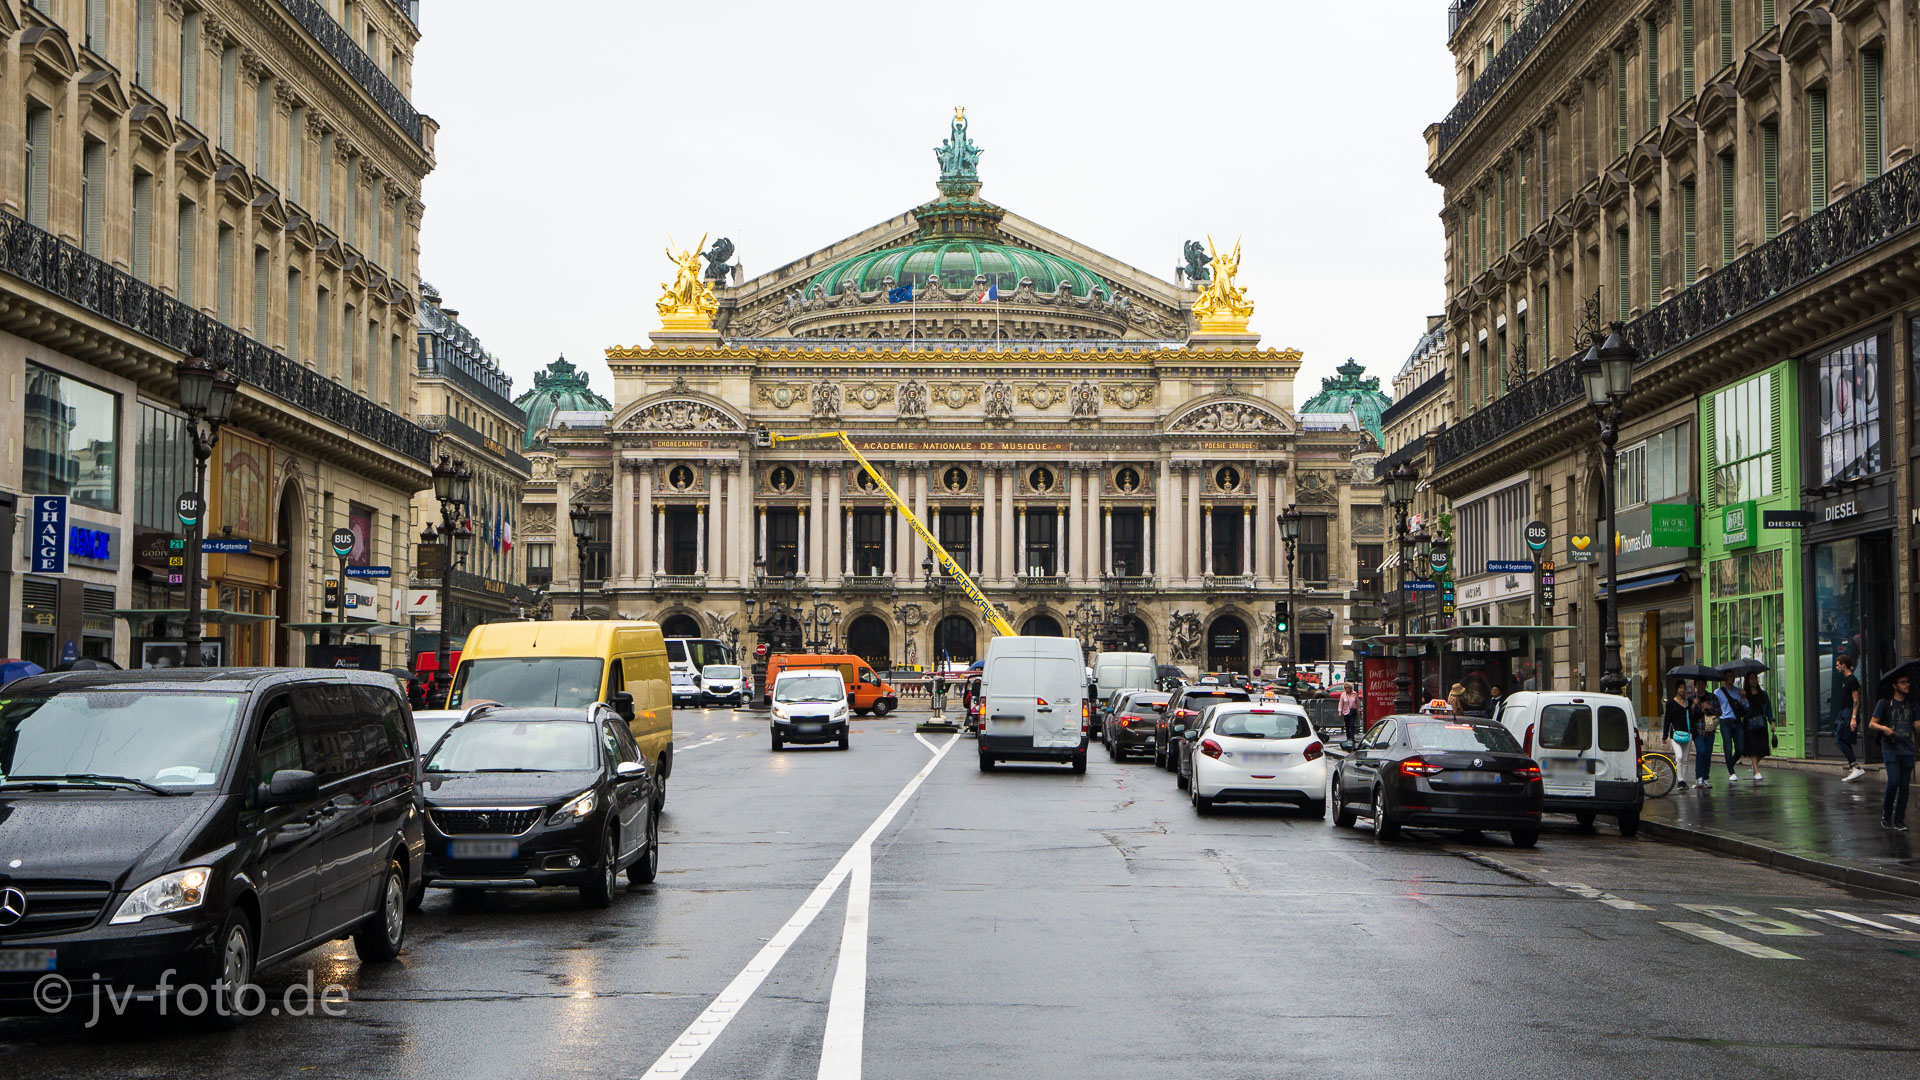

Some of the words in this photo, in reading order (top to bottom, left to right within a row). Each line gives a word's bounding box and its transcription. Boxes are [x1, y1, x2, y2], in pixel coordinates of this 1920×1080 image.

[863, 442, 914, 450] ACADEMIE
[922, 442, 972, 450] NATIONALE
[980, 442, 993, 450] DE
[1001, 442, 1048, 451] MUSIQUE
[180, 499, 197, 511] BU
[1825, 500, 1858, 522] DIESEL
[41, 499, 59, 570] CHANGE
[1528, 528, 1546, 538] BUS
[69, 525, 110, 560] ANGE
[334, 534, 352, 543] BUS
[1620, 534, 1641, 554] Thomas
[1640, 529, 1652, 549] Coo
[172, 540, 182, 548] 21
[219, 543, 248, 551] Septembre
[171, 557, 181, 566] 68
[1431, 553, 1447, 561] BUS
[1543, 562, 1553, 570] 27
[951, 565, 1000, 623] VERTIKALOC
[1369, 669, 1384, 679] UNE
[1370, 680, 1396, 691] MUTUE
